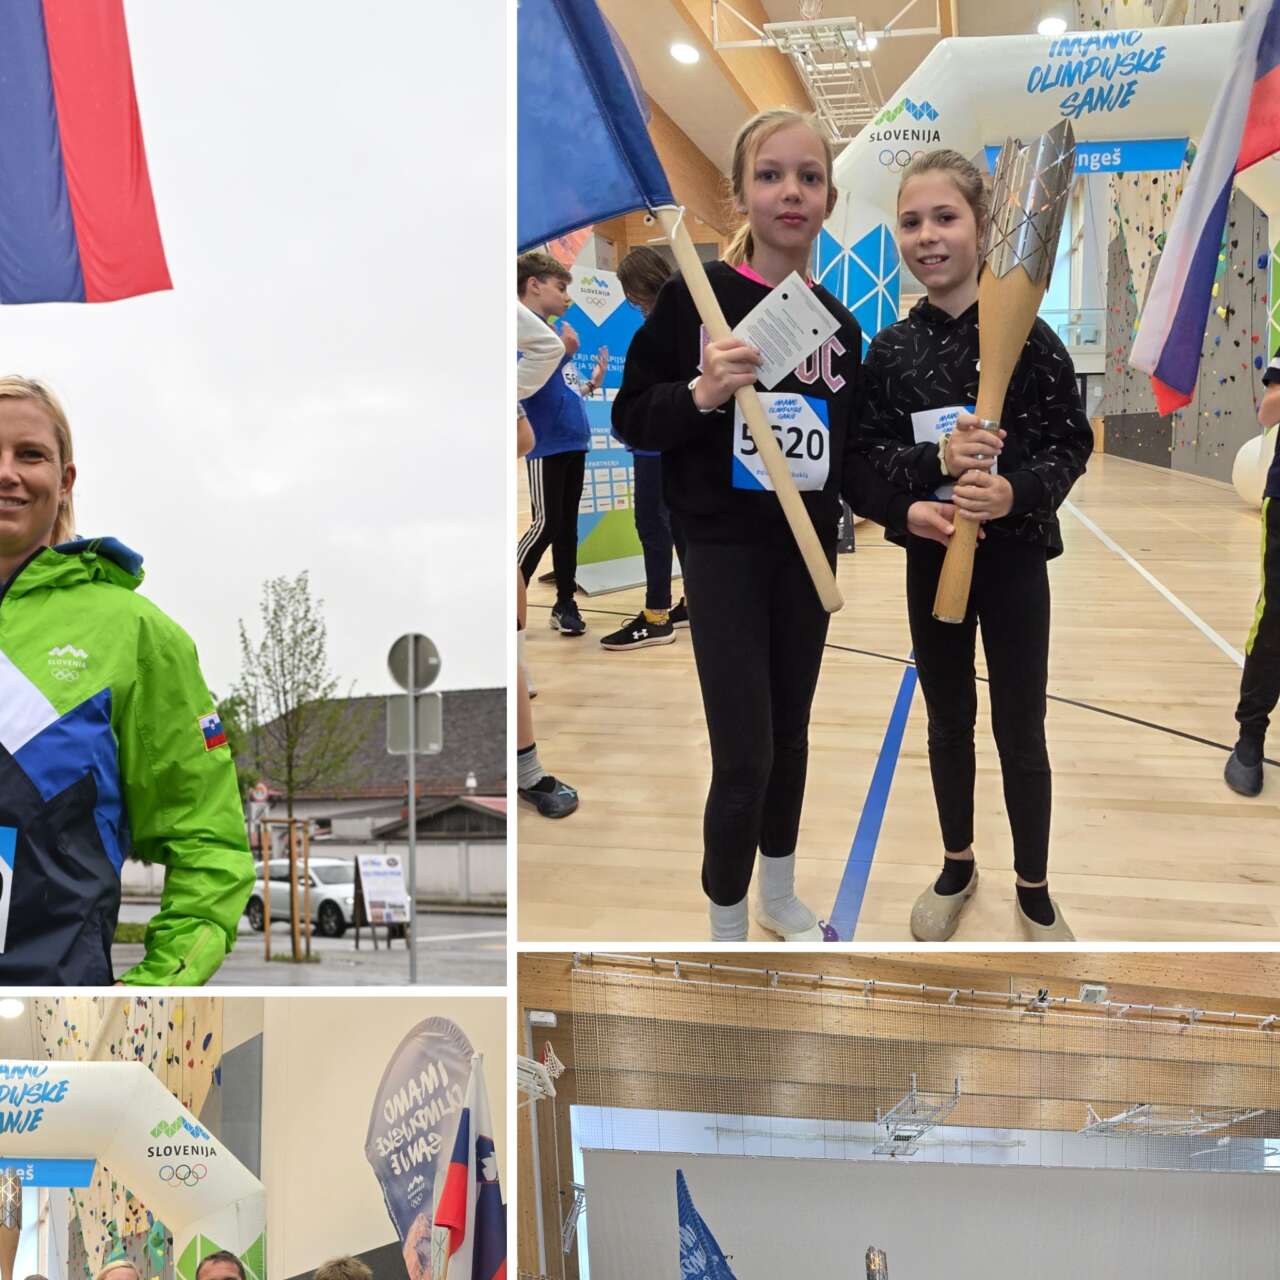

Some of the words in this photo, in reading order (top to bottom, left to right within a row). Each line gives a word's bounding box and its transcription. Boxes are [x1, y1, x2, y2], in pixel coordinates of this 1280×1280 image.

[1026, 45, 1167, 94] OLIMPIJSKE
[1059, 80, 1139, 120] SANJE
[868, 128, 942, 144] SLOVENIJA
[1075, 147, 1121, 172] ngeš
[146, 1144, 218, 1159] SLOVENIJA
